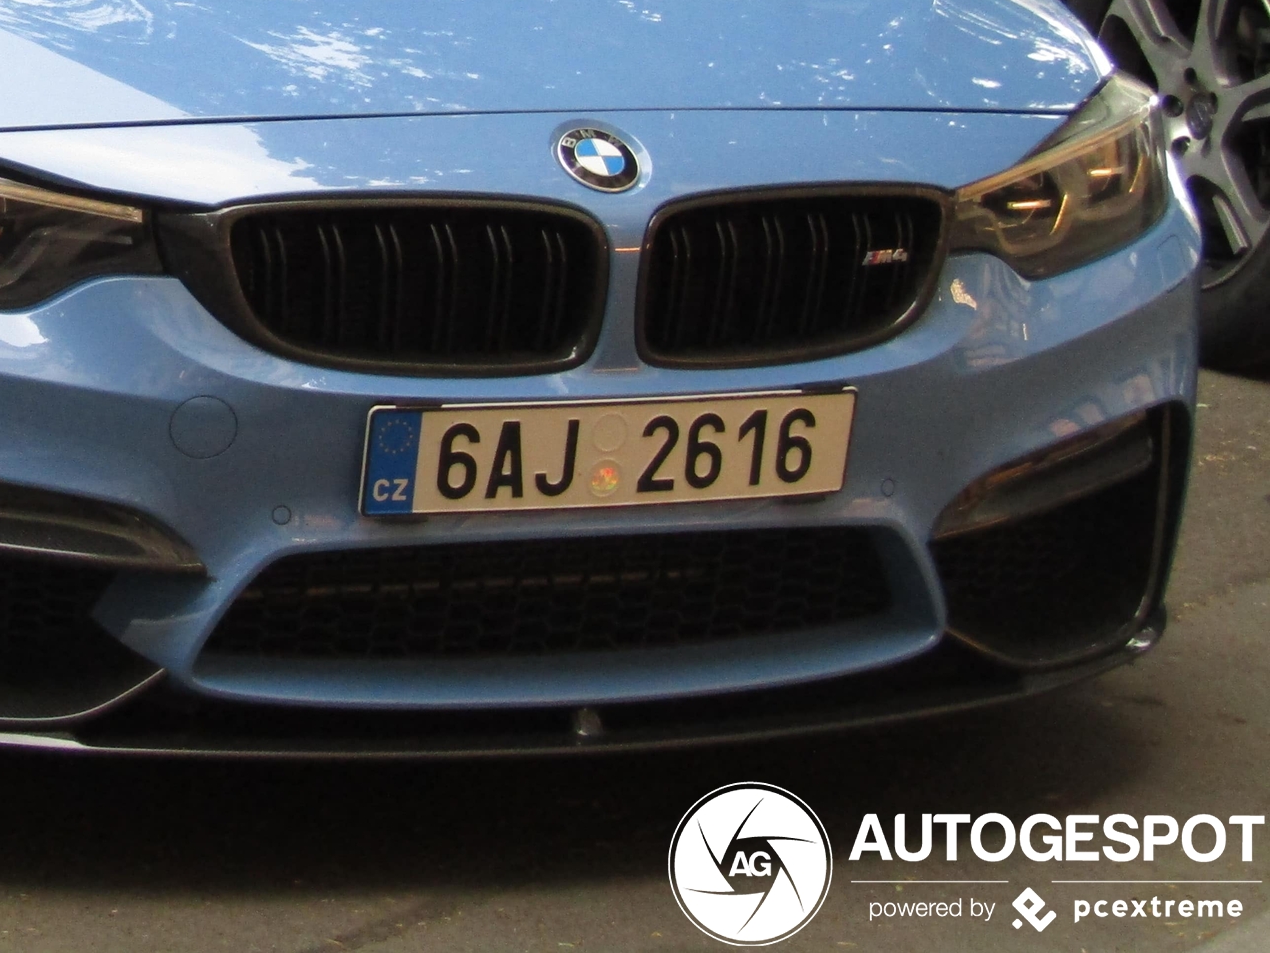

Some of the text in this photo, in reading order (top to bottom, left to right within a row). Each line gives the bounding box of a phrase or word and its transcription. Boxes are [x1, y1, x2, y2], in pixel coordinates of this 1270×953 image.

[561, 129, 623, 148] BMW
[436, 408, 817, 500] 6AJ 2616
[372, 478, 408, 502] CZ
